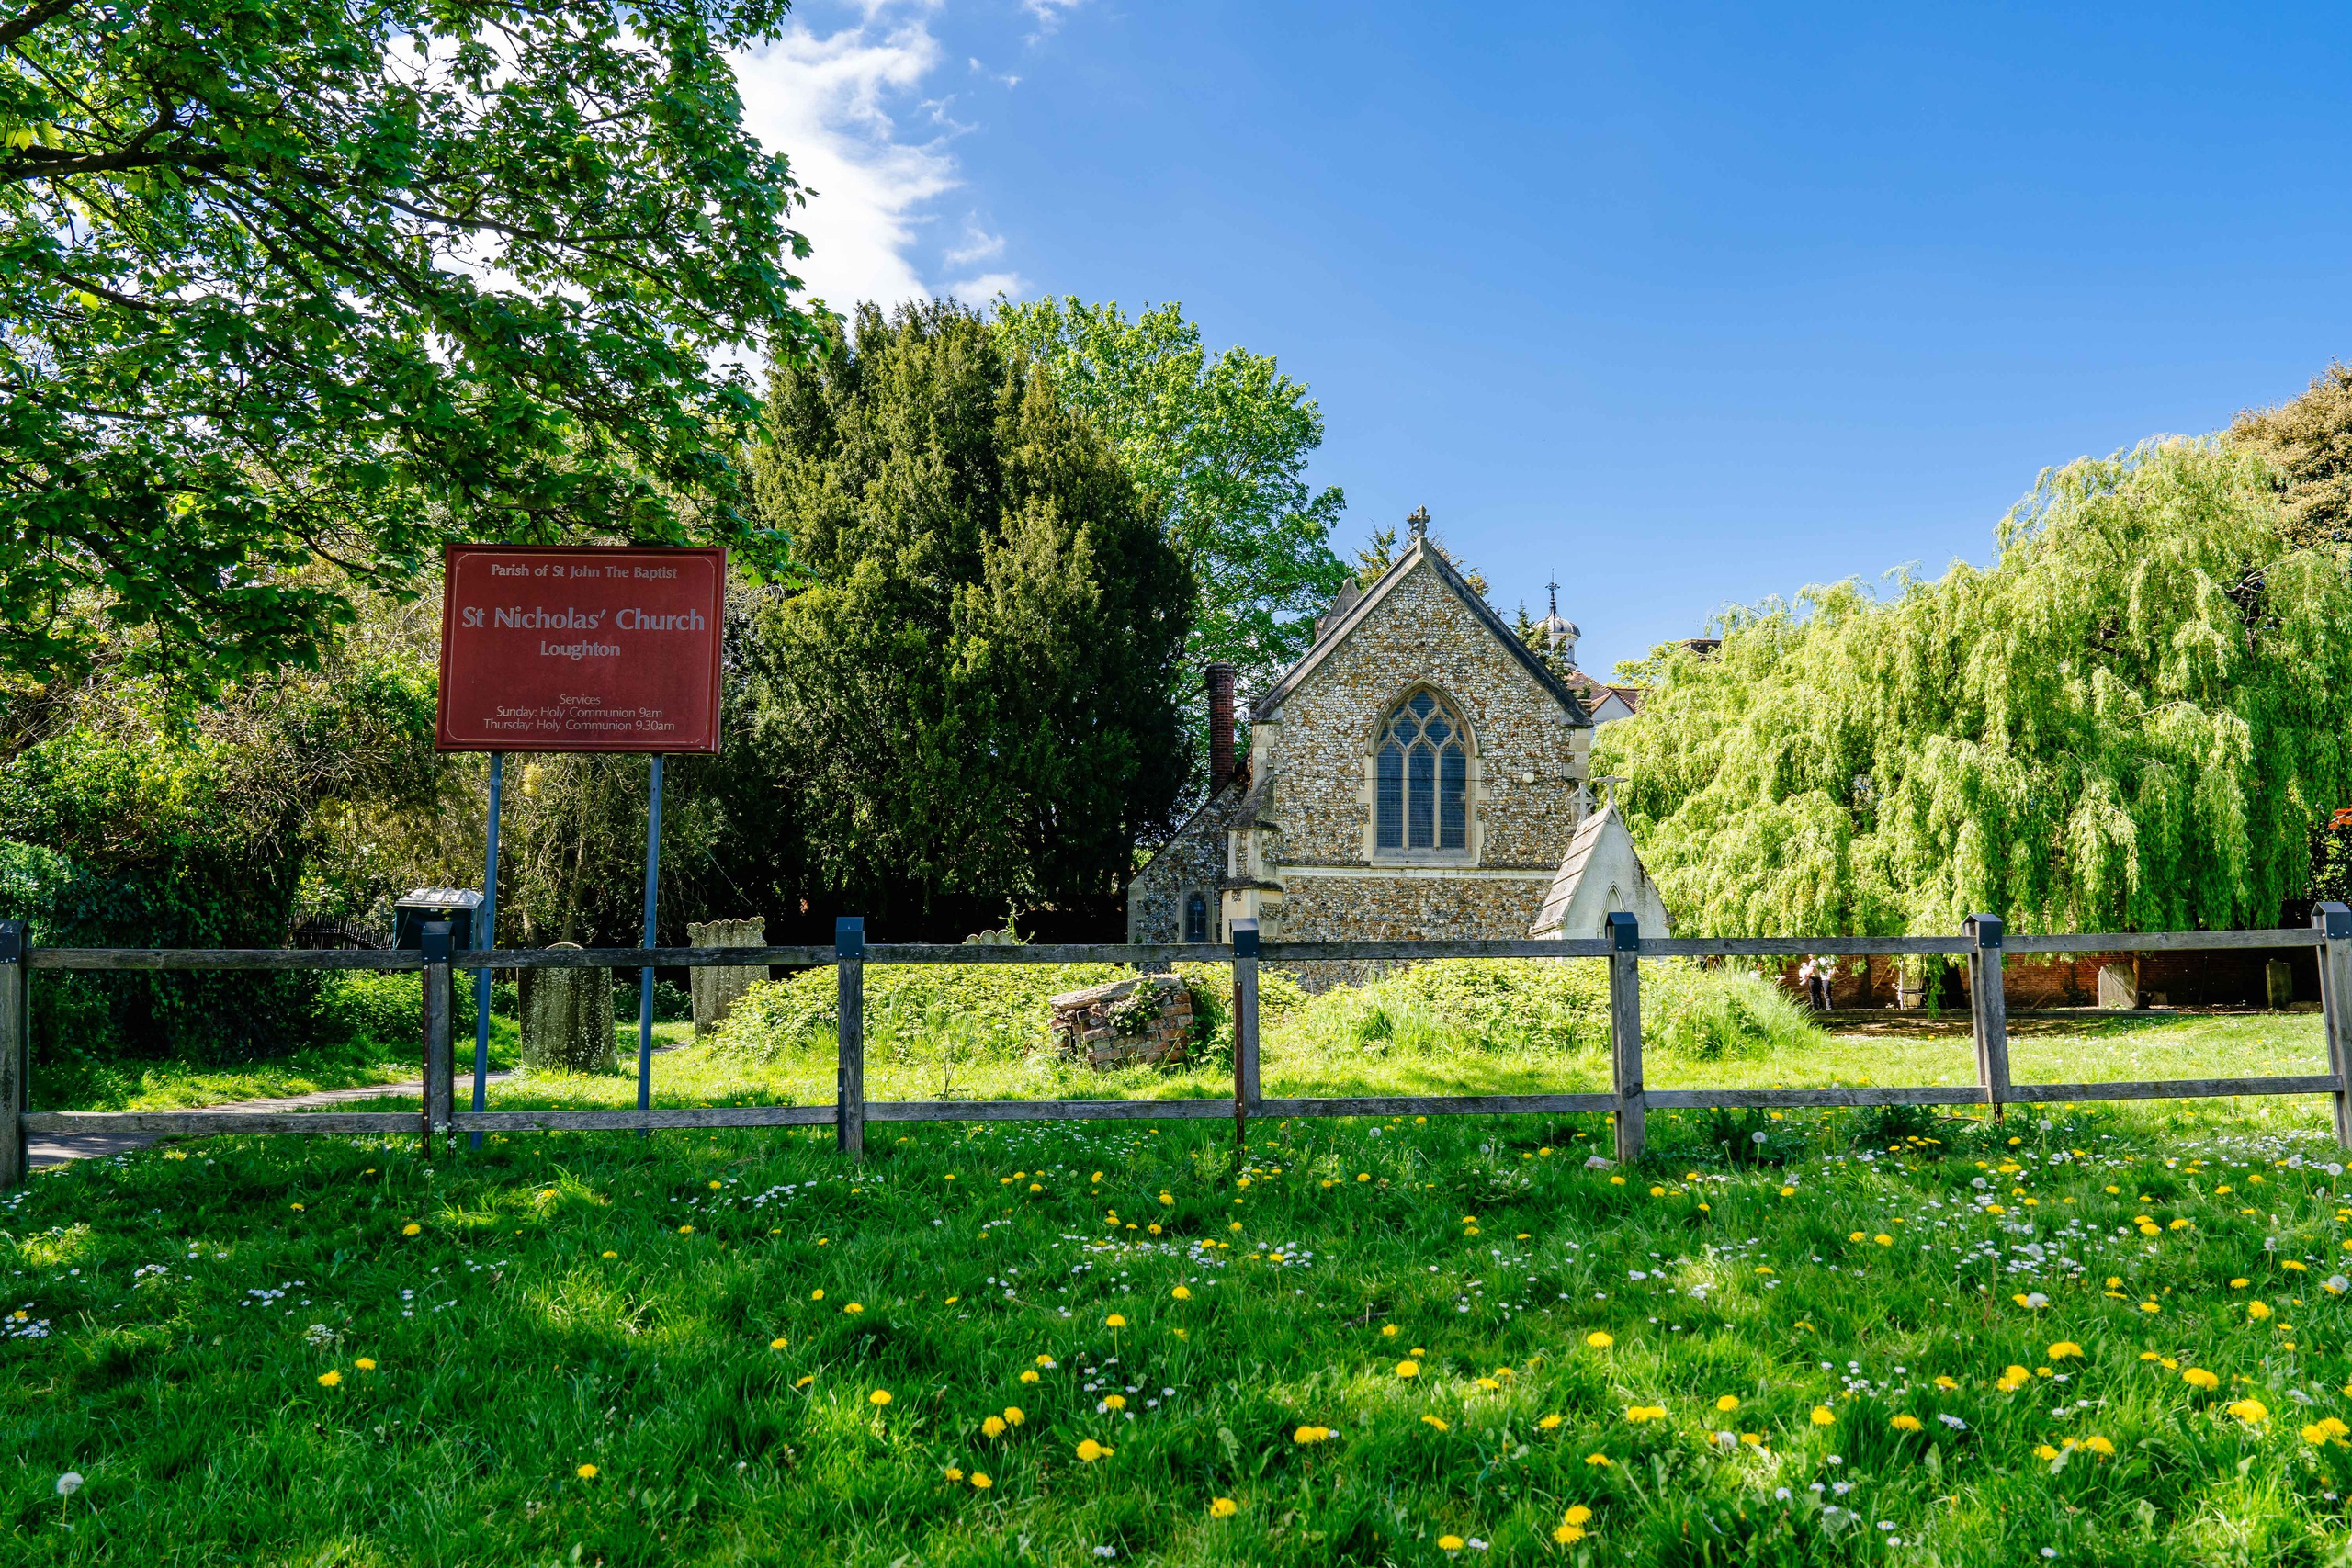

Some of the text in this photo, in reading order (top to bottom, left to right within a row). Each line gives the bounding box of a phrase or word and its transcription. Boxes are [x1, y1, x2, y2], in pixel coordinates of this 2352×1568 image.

[491, 563, 677, 581] Parish of St John The Baptist
[461, 606, 705, 631] St Nicholas' Church
[540, 639, 621, 660] Loughton
[560, 694, 601, 705] Services
[496, 705, 662, 718] Sunday: Holy Communion 9am
[483, 718, 675, 732] Thursday: Holy Communion 9.30am
